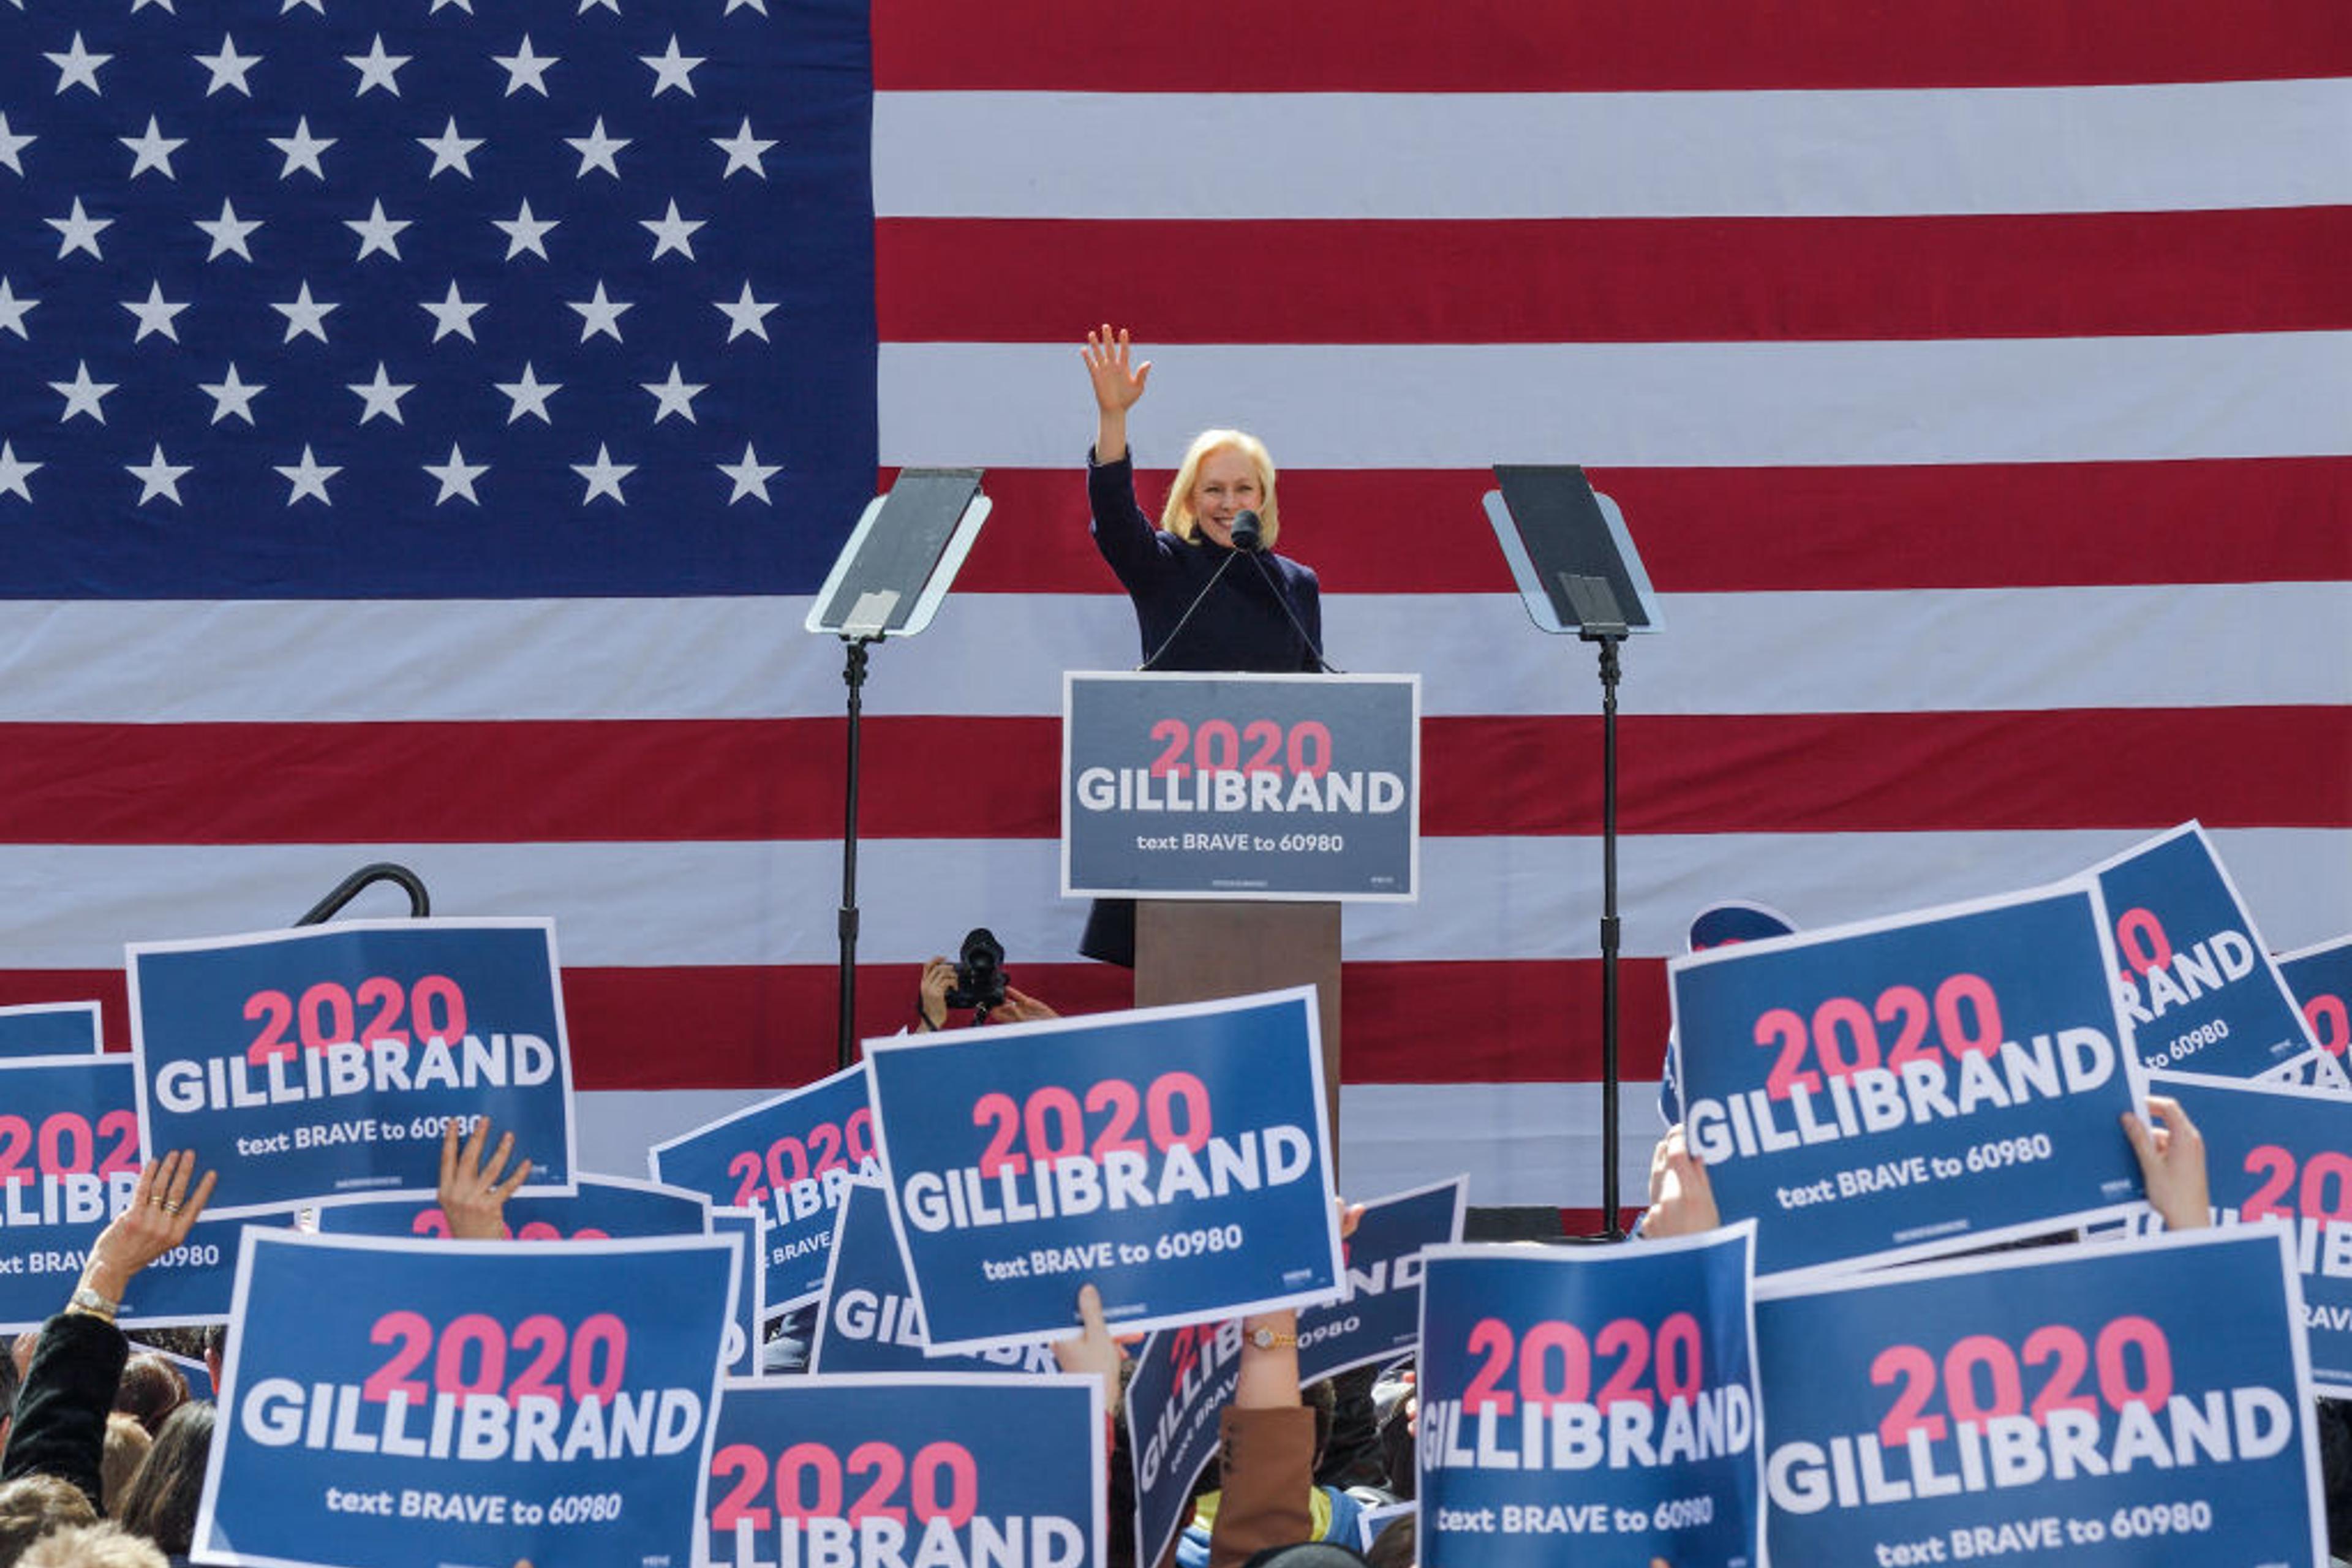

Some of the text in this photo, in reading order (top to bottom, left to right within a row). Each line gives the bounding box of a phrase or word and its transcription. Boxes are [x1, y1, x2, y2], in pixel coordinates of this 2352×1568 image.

[1077, 767, 1404, 813] GILLIBRAND
[1150, 718, 1332, 780] 2020
[1137, 834, 1342, 851] text BRAVE to 60980
[243, 975, 467, 1066] 2020
[1754, 973, 2003, 1102] 2020
[2170, 1019, 2229, 1060] 60980
[156, 1034, 554, 1112] GILLIBRAND
[1688, 1027, 2115, 1166] GILLIBRAND
[236, 1133, 290, 1156] text
[295, 1119, 377, 1150] BRAVE
[381, 1121, 405, 1140] to
[728, 1108, 878, 1207] 2020
[973, 1072, 1212, 1179] 2020
[903, 1125, 1311, 1232] GILLIBRAND
[1776, 1133, 2051, 1209] text BRAVE to 60980
[773, 1231, 832, 1265] BRAVE
[983, 1224, 1242, 1281] text BRAVE to 60980
[363, 1311, 627, 1410] 2020
[1462, 1312, 1702, 1418] 2020
[1870, 1316, 2174, 1447] 2020
[243, 1378, 701, 1461] GILLIBRAND
[1423, 1384, 1751, 1472] GILLIBRAND
[1767, 1387, 2292, 1514] GILLIBRAND
[326, 1487, 621, 1525] text BRAVE to 60980
[712, 1441, 977, 1531] 2020
[1439, 1496, 1713, 1532] text BRAVE to 60980
[1877, 1501, 2212, 1568] text BRAVE to 60980
